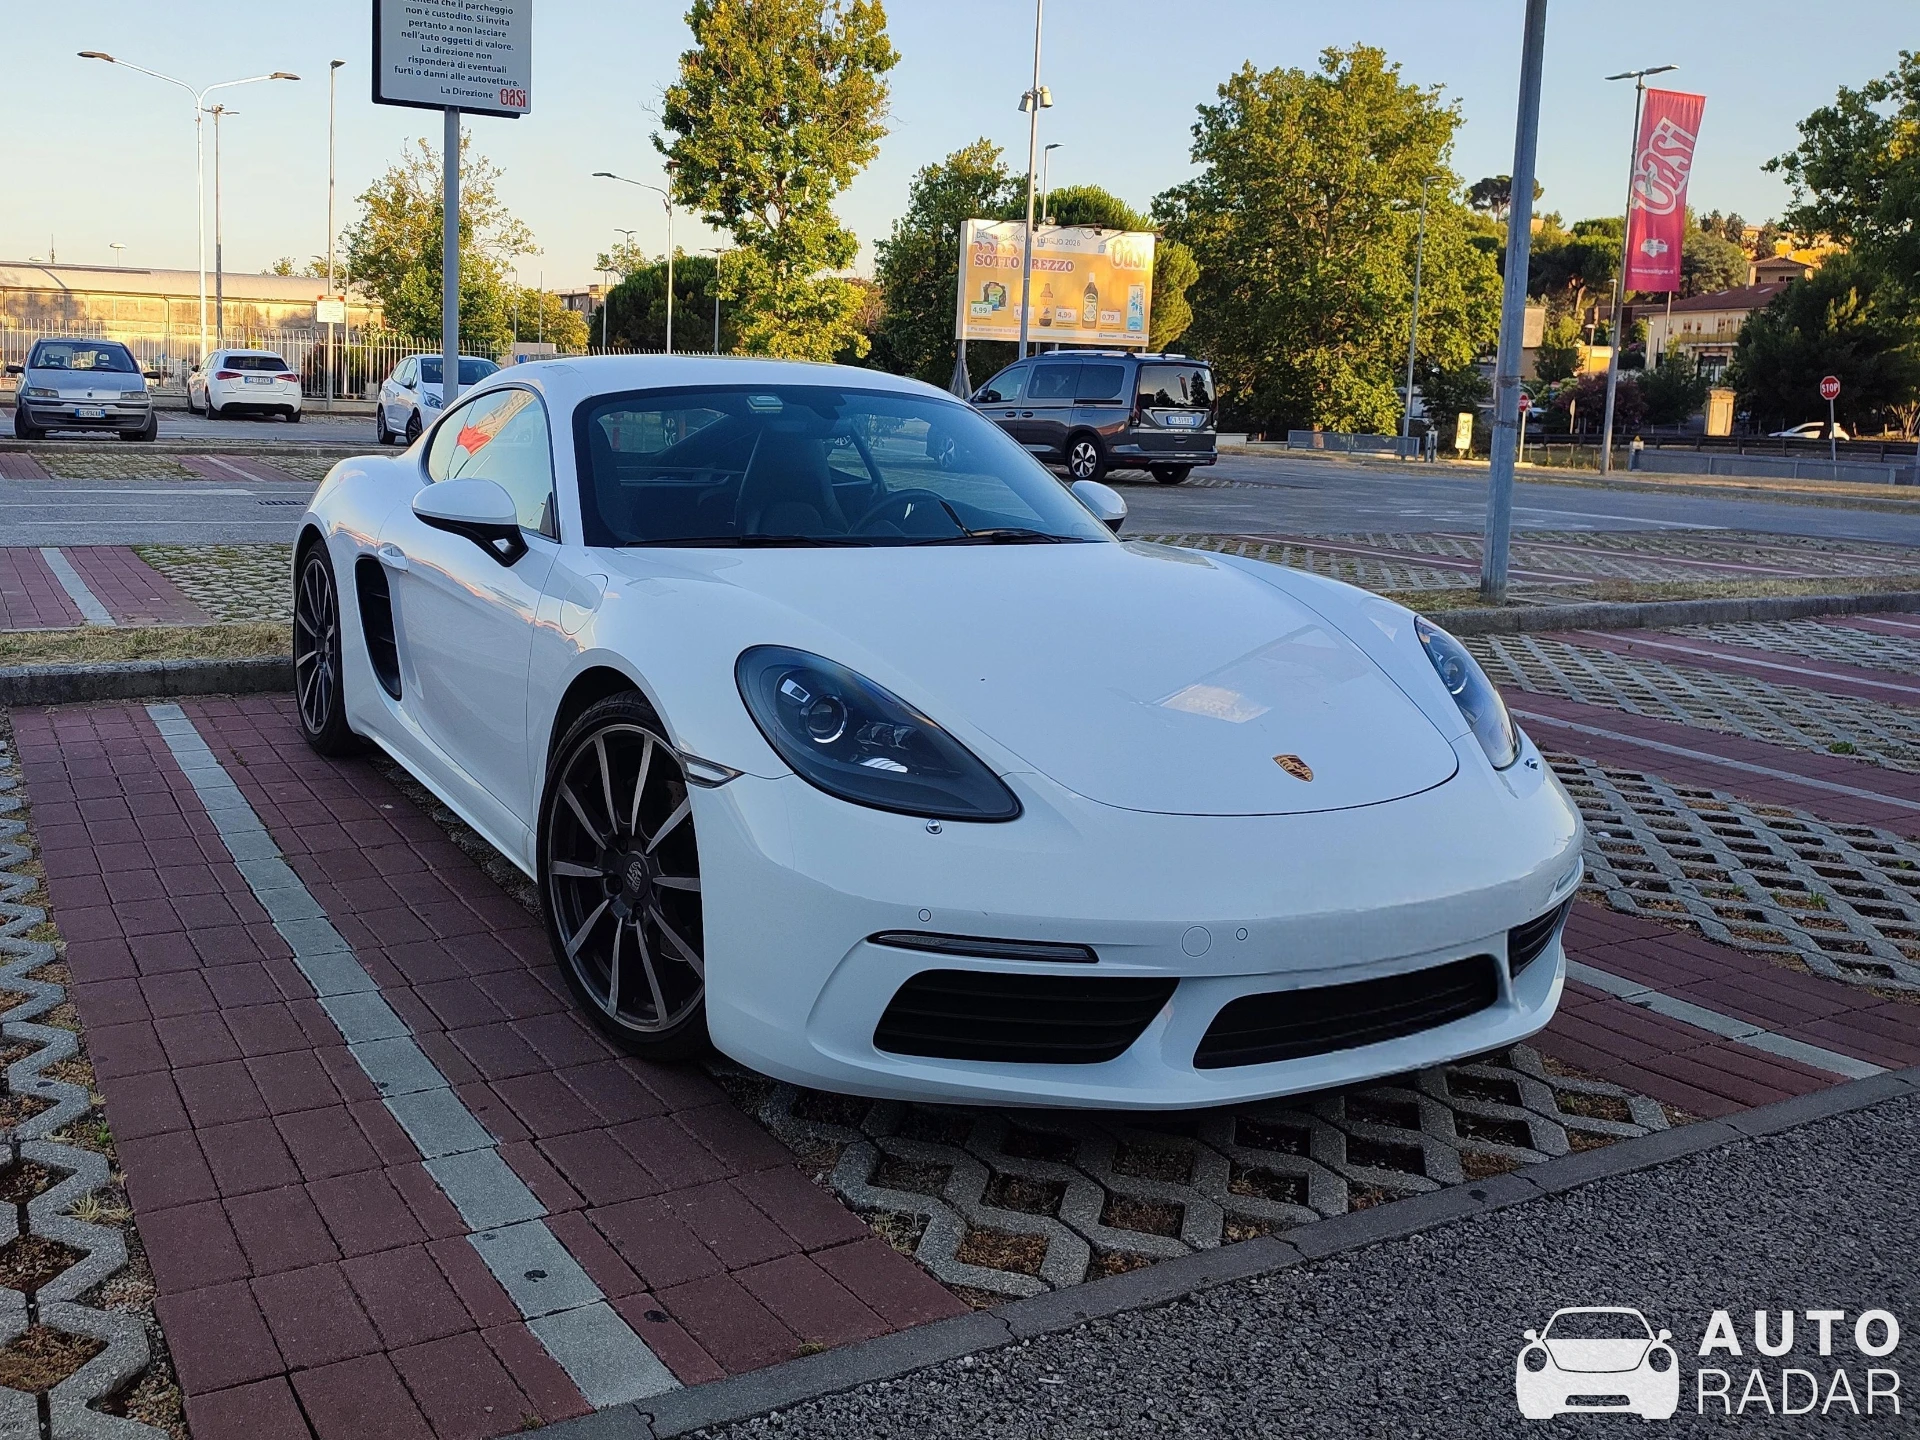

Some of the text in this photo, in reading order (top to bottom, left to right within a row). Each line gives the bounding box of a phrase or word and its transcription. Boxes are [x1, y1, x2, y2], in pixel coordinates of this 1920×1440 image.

[405, 7, 510, 26] non è custodito. Si invita
[458, 0, 464, 8] il
[465, 3, 514, 15] parcheggio
[408, 19, 447, 30] pertanto
[456, 26, 473, 34] non
[474, 26, 507, 38] lasciare
[401, 30, 514, 51] nell'auto oggetti di valore.
[421, 43, 492, 60] La direzione non
[408, 54, 507, 74] risponderà di eventuali
[394, 65, 414, 75] furti
[423, 68, 448, 79] danni
[450, 72, 466, 81] alle
[467, 75, 520, 87] autovetture.
[440, 85, 494, 98] La Direzione
[976, 231, 989, 240] DAL
[975, 254, 1075, 272] SOTTO REZZO
[1821, 383, 1839, 393] STOP
